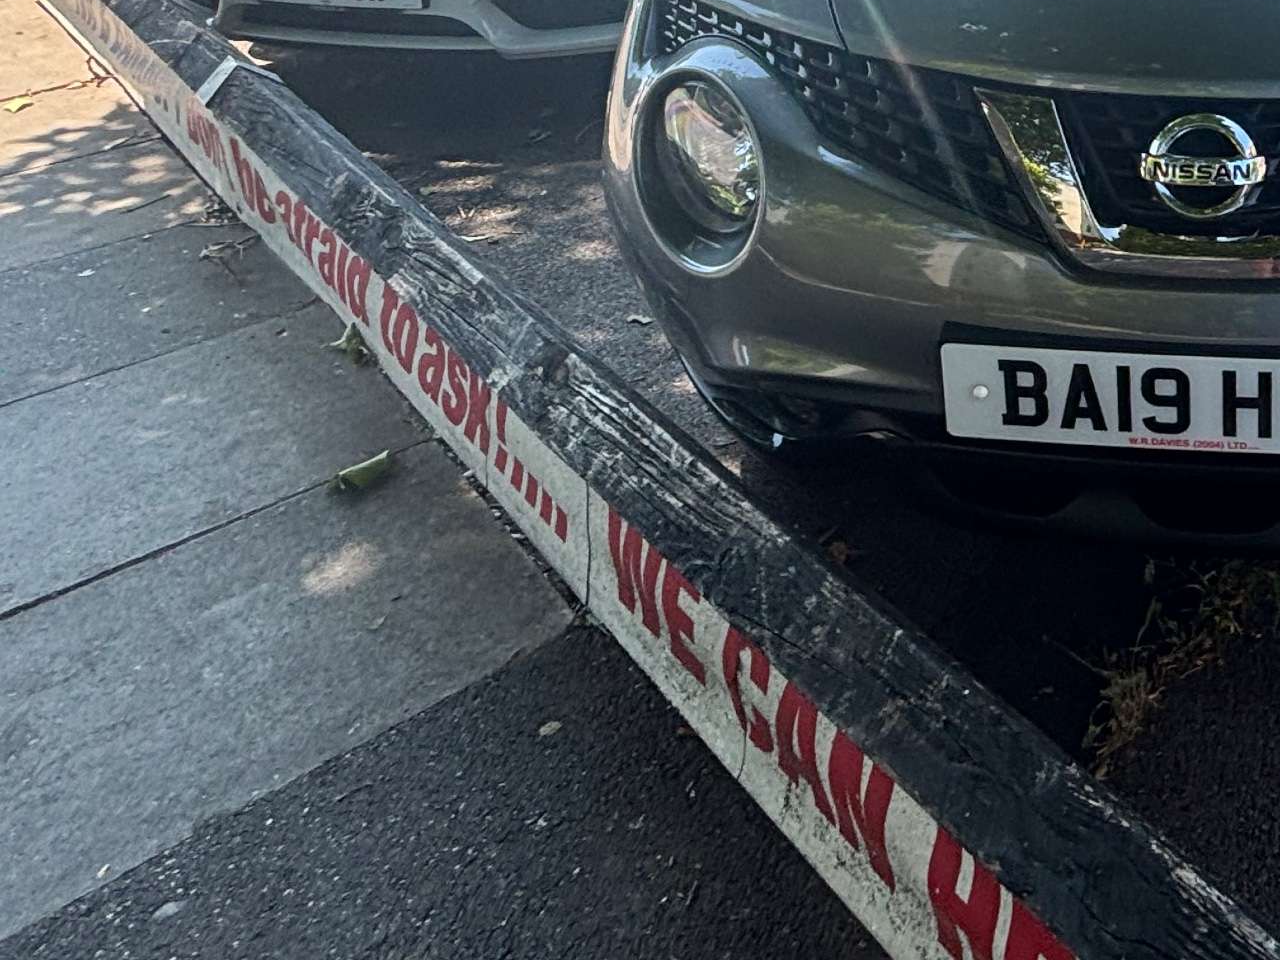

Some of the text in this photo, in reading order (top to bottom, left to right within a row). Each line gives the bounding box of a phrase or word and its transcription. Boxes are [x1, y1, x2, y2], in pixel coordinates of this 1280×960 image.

[1153, 161, 1250, 180] NISSAN
[998, 358, 1191, 435] BA19
[275, 190, 373, 327] afraid
[380, 279, 420, 375] to
[608, 502, 707, 686] WE
[722, 622, 897, 895] CAN
